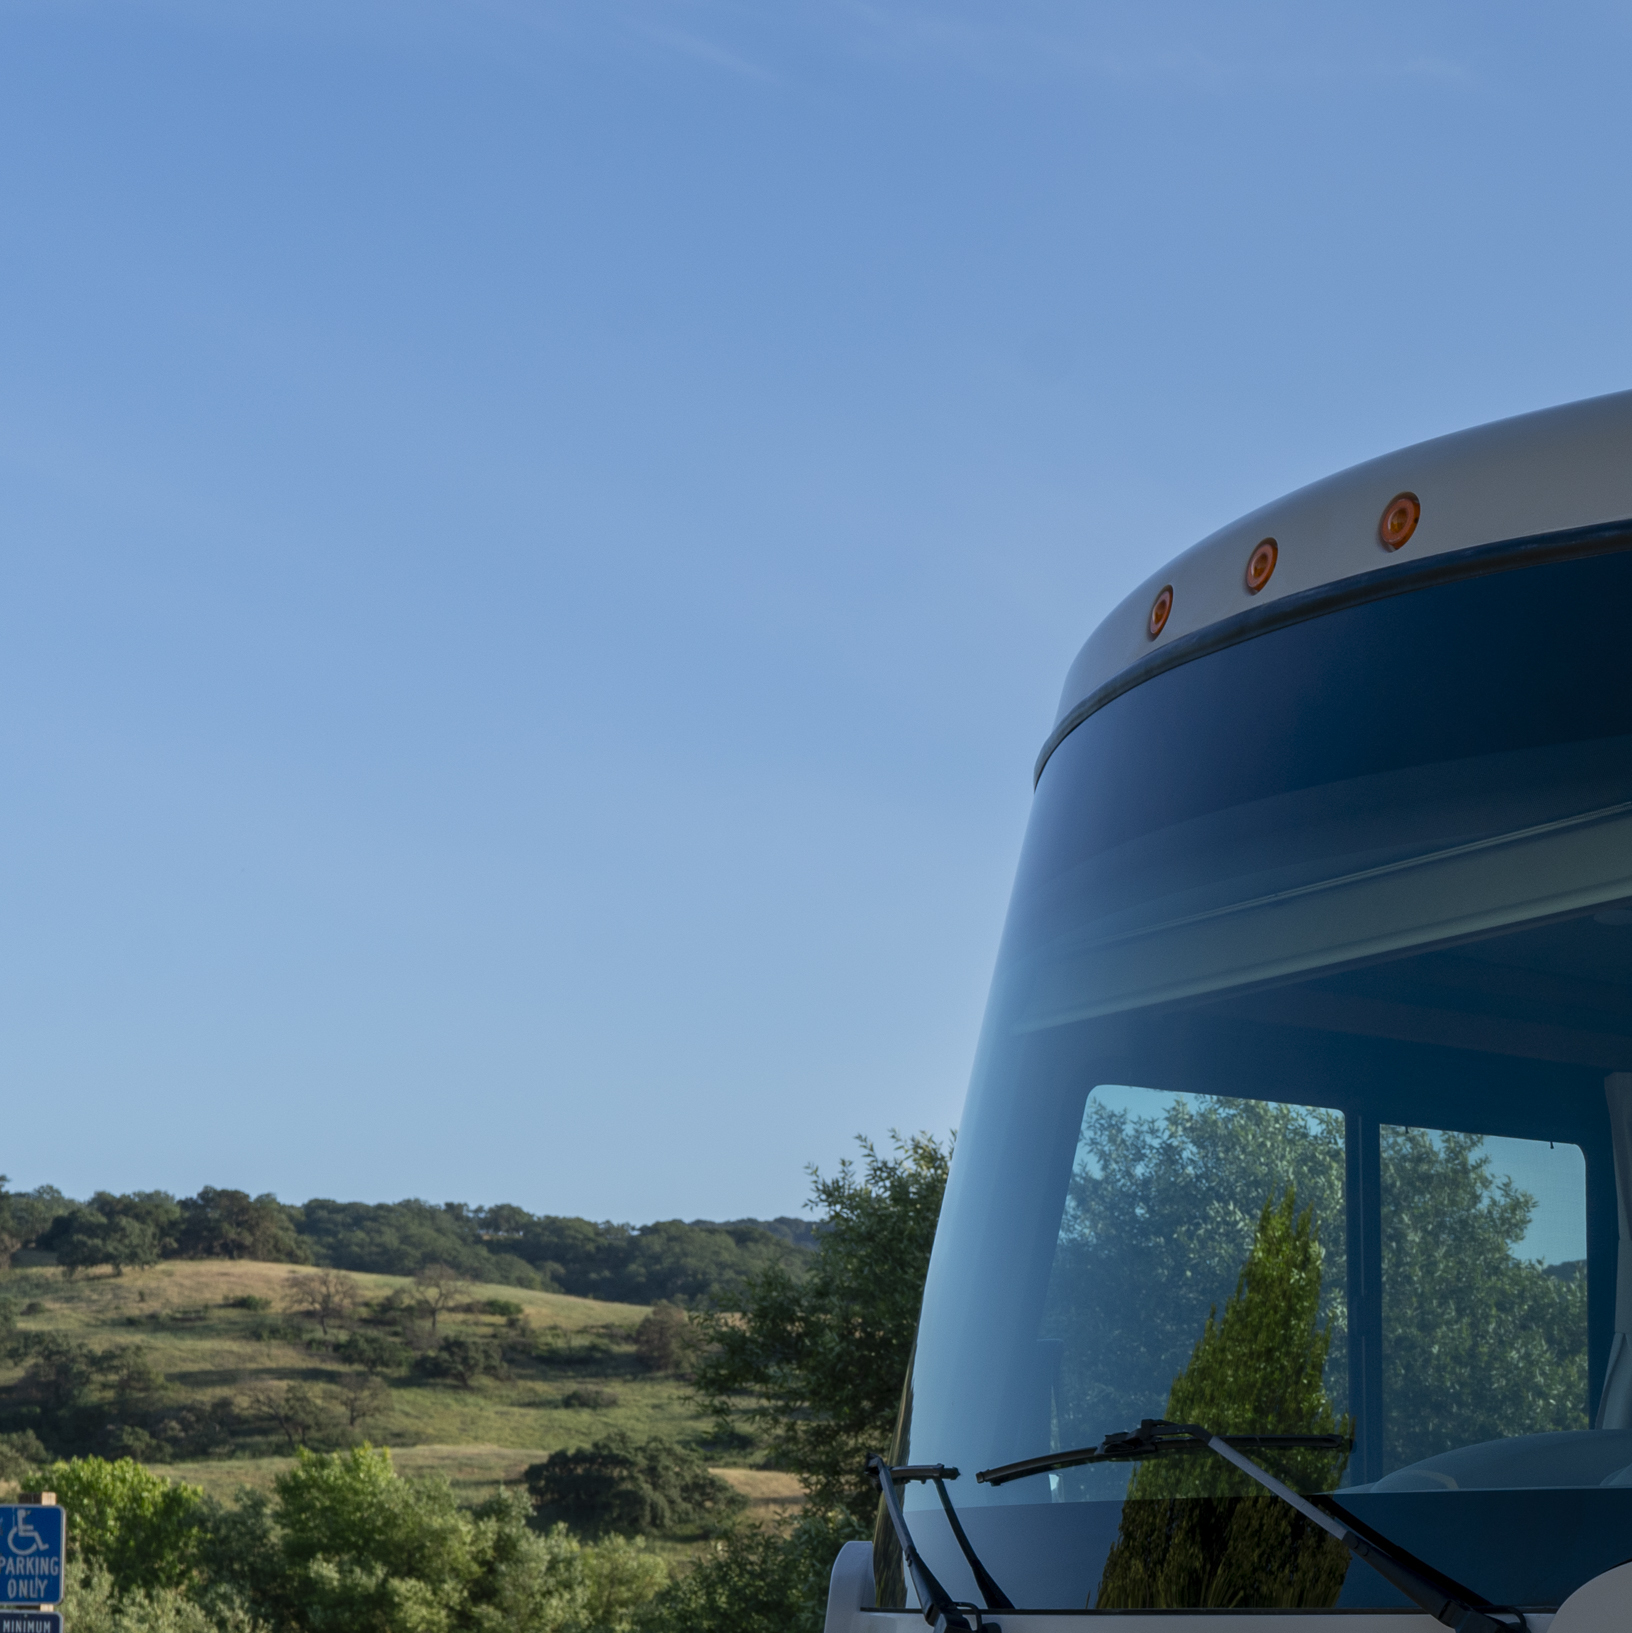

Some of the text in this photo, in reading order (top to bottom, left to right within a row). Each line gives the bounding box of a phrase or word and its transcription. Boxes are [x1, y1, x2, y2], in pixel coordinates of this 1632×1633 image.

[0, 1556, 60, 1576] PARKING
[7, 1578, 48, 1599] ONLY
[2, 1619, 51, 1633] MINIMUM
